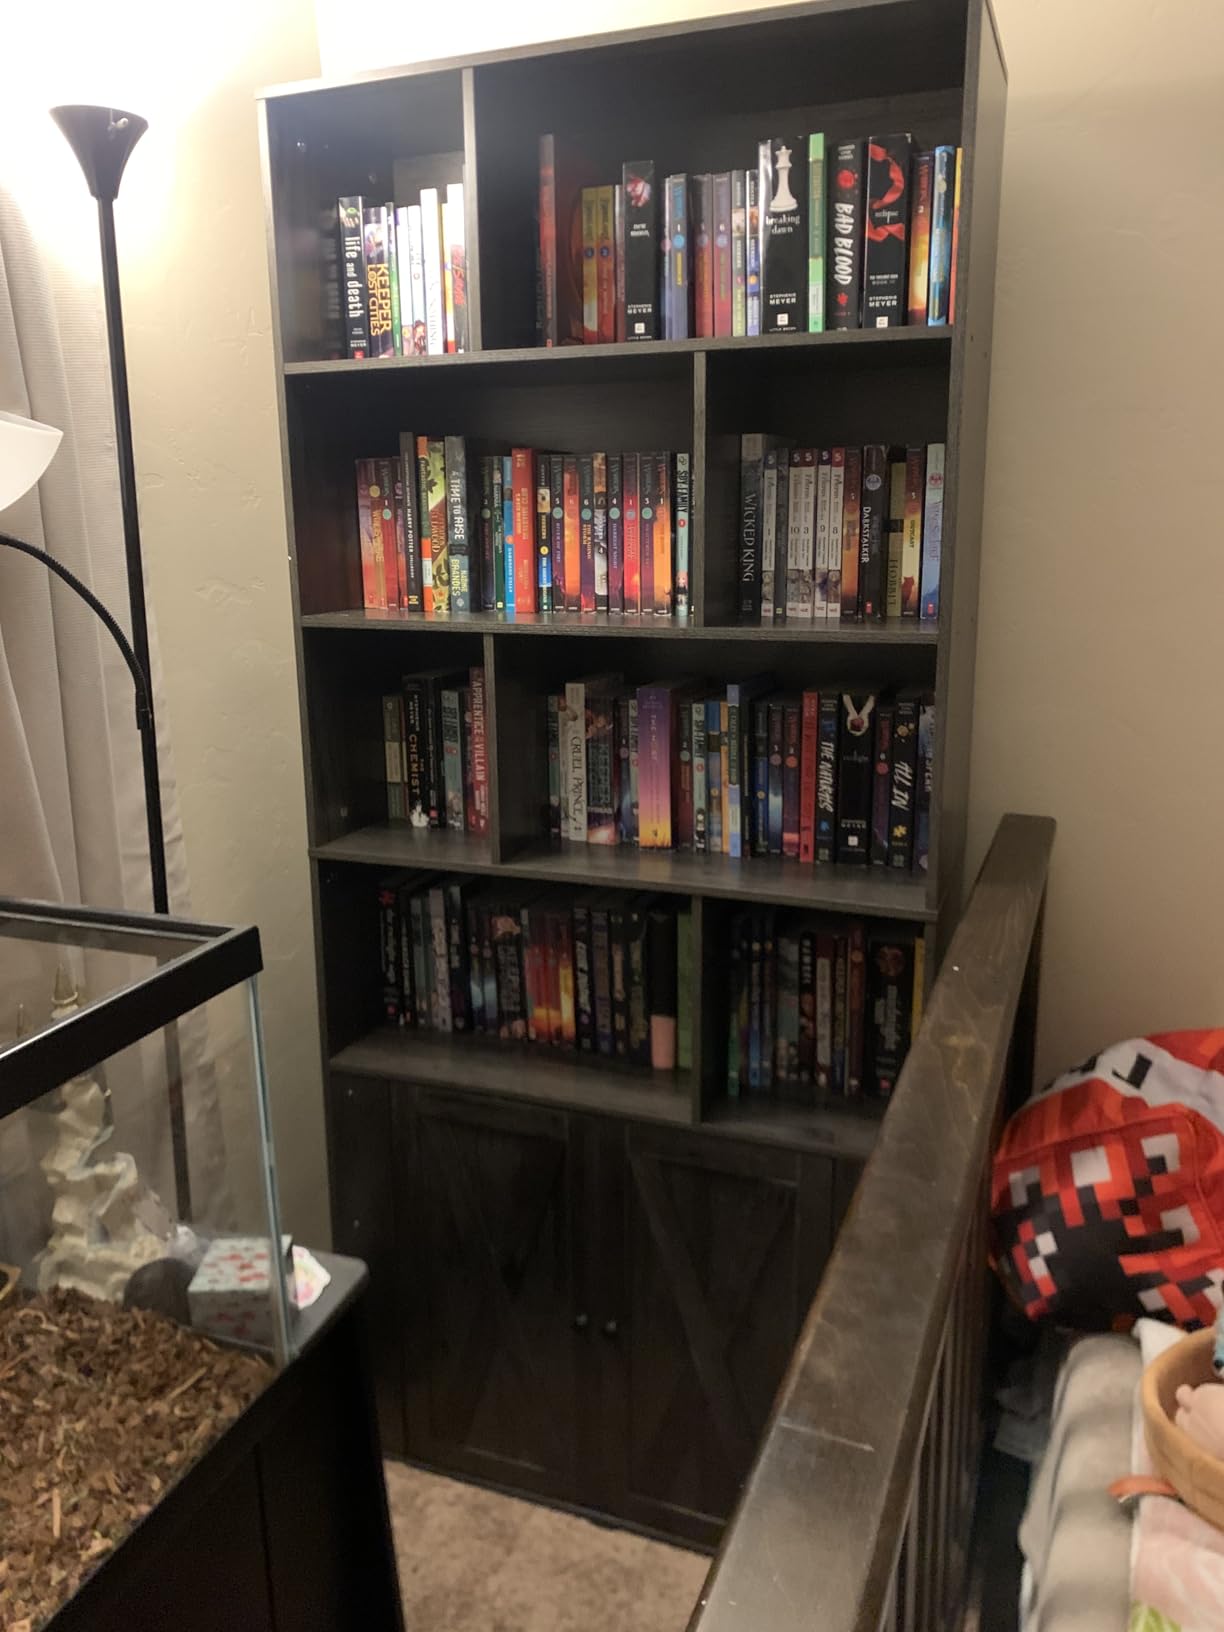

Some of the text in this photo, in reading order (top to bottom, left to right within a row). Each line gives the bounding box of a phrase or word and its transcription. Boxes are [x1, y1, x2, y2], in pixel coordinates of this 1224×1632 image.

[766, 214, 800, 226] breaking
[771, 225, 793, 234] dawn
[834, 202, 854, 285] BAD BLOOD
[344, 236, 363, 259] life
[346, 263, 356, 277] and
[347, 281, 364, 318] death
[368, 264, 379, 336] LOST CITIES
[377, 263, 391, 334] KEEPER
[450, 479, 461, 503] TIME
[453, 505, 461, 514] TO
[454, 516, 464, 540] RISE
[740, 493, 756, 582] WICKED KING
[861, 506, 872, 563] DARKSTALKER
[451, 559, 461, 596] BRANDES
[888, 559, 899, 607] HOBBIT
[472, 680, 484, 735] APPRENTICE
[409, 734, 419, 795] CHEMIST
[474, 743, 485, 781] VILLAIN
[570, 736, 585, 816] CRUEL PRINCE
[818, 741, 834, 813] THE NATURALS
[891, 762, 913, 811] ALL IN
